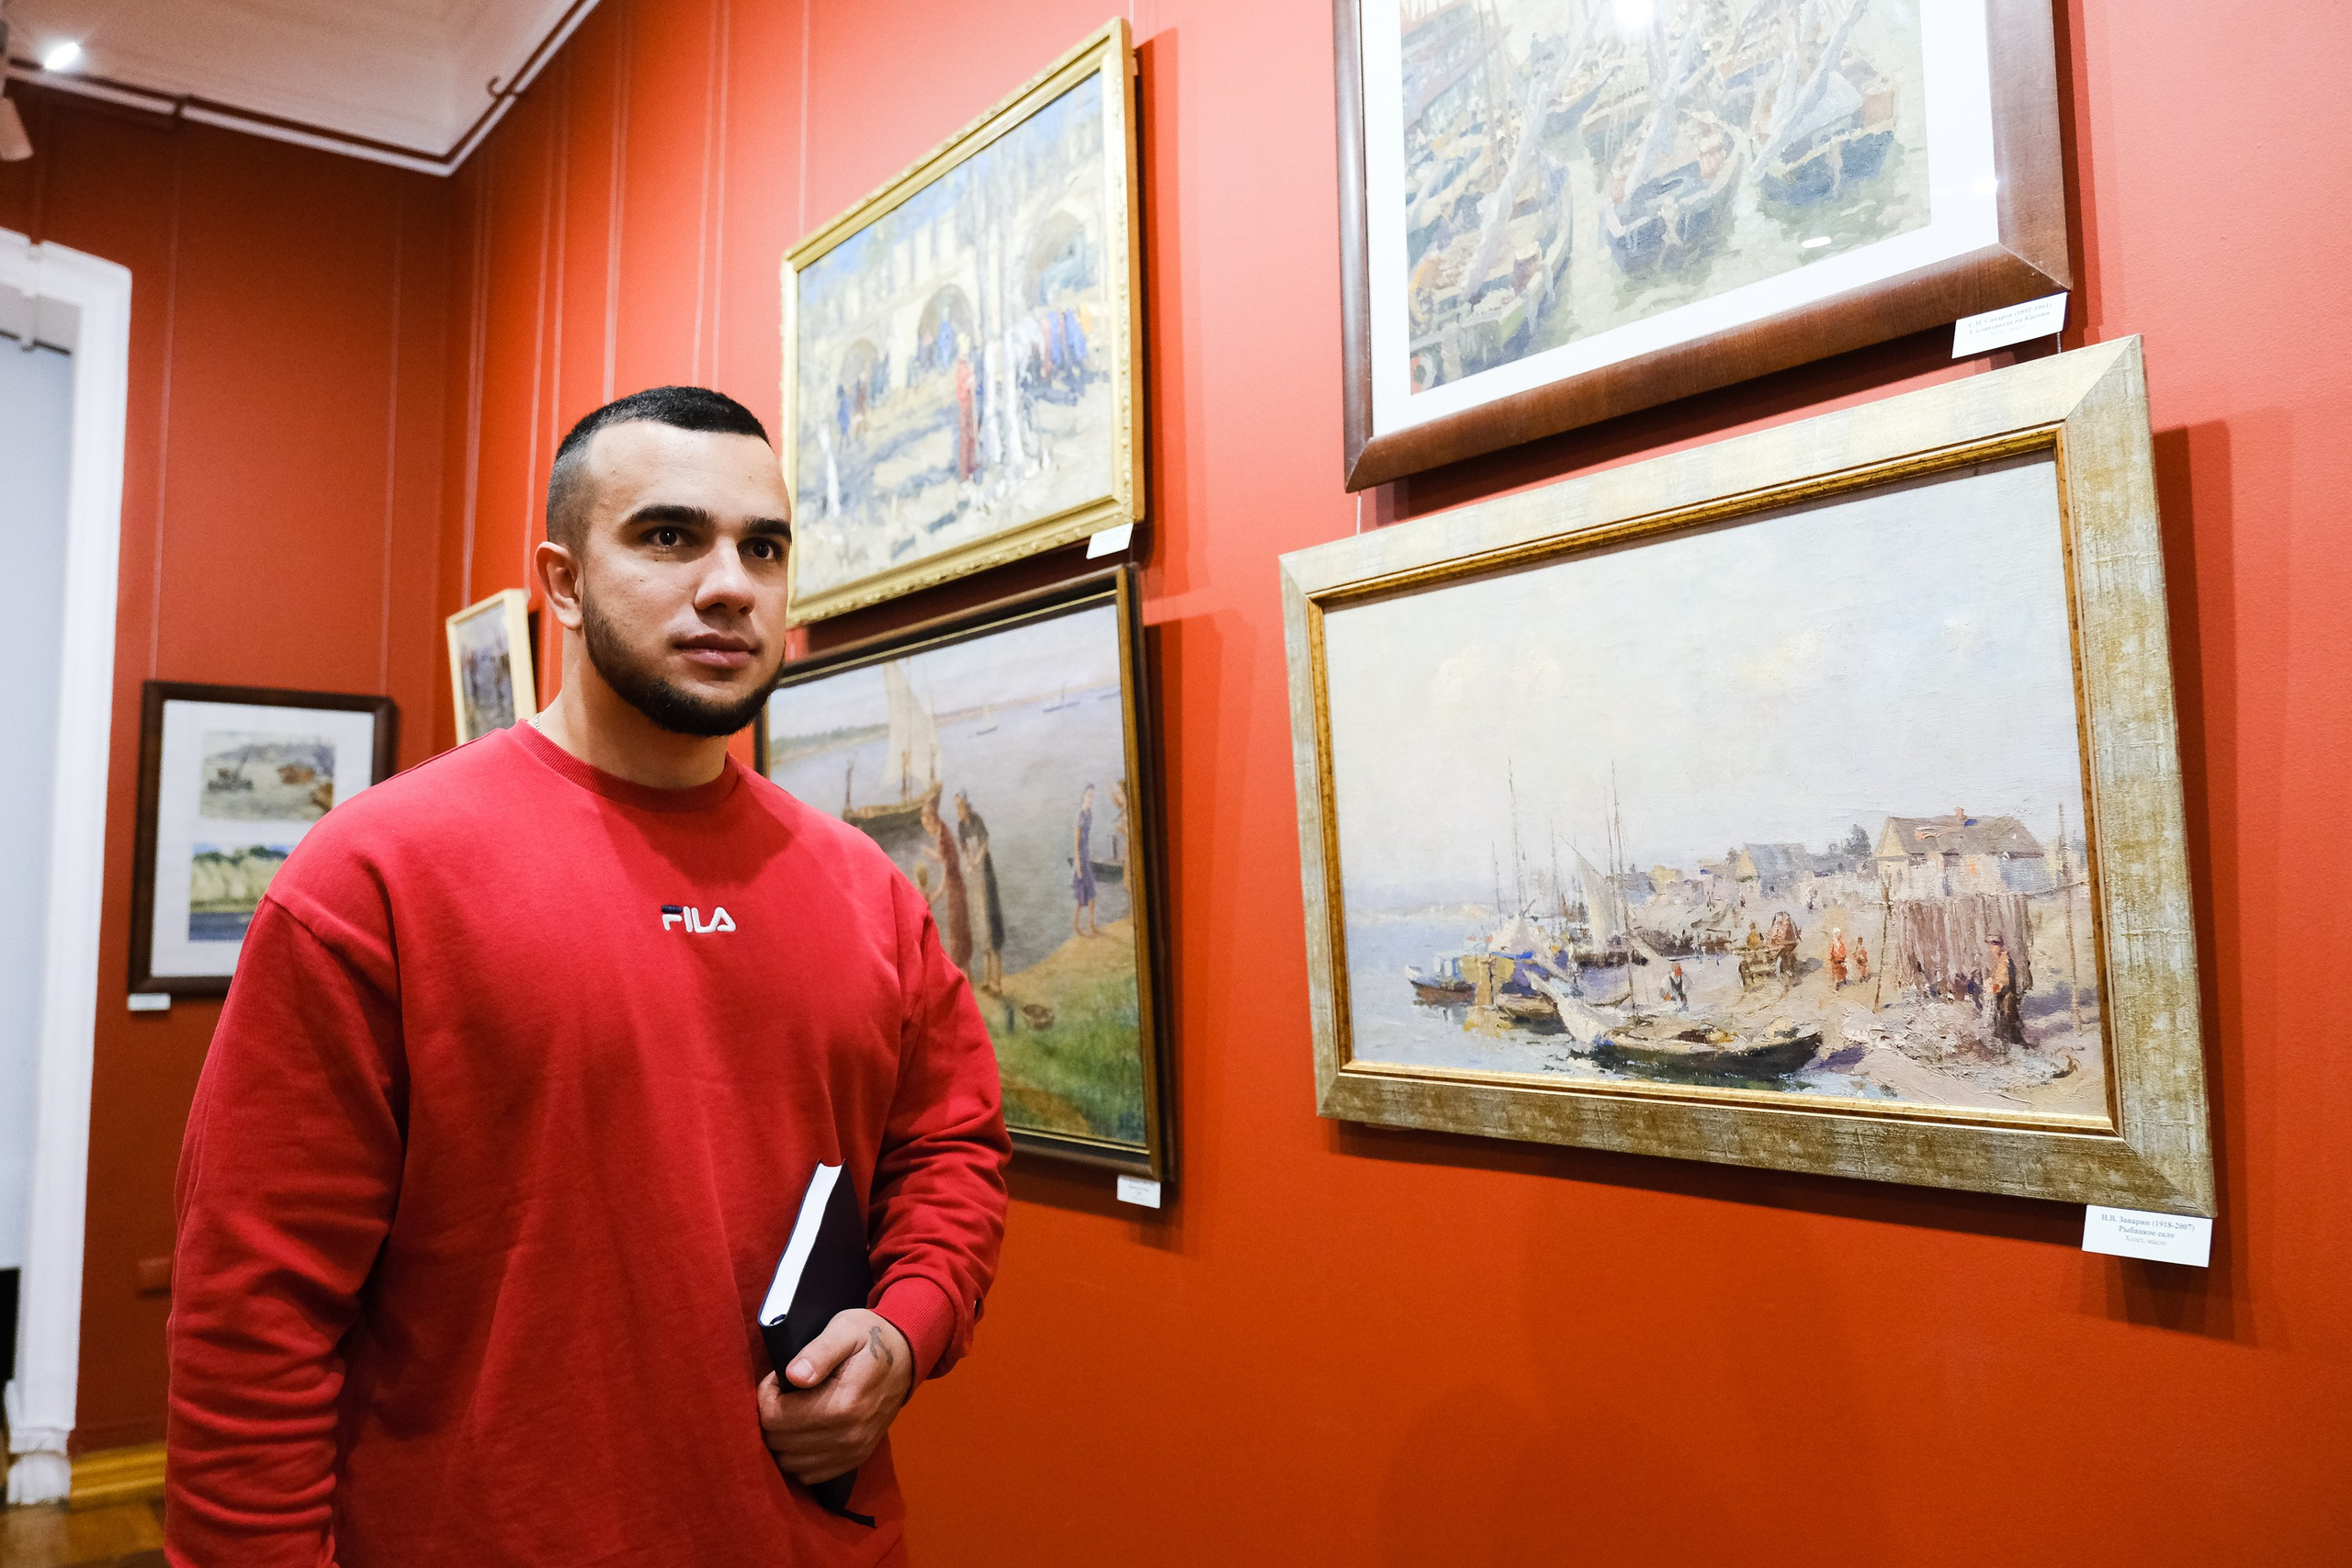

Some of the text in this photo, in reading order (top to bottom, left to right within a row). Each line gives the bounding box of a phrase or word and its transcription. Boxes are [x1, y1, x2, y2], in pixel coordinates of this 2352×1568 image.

[661, 905, 737, 934] FILA
[2101, 1214, 2195, 1231] Н.В. Заварин (1918-2007)
[2119, 1225, 2155, 1236] Рыбацкое
